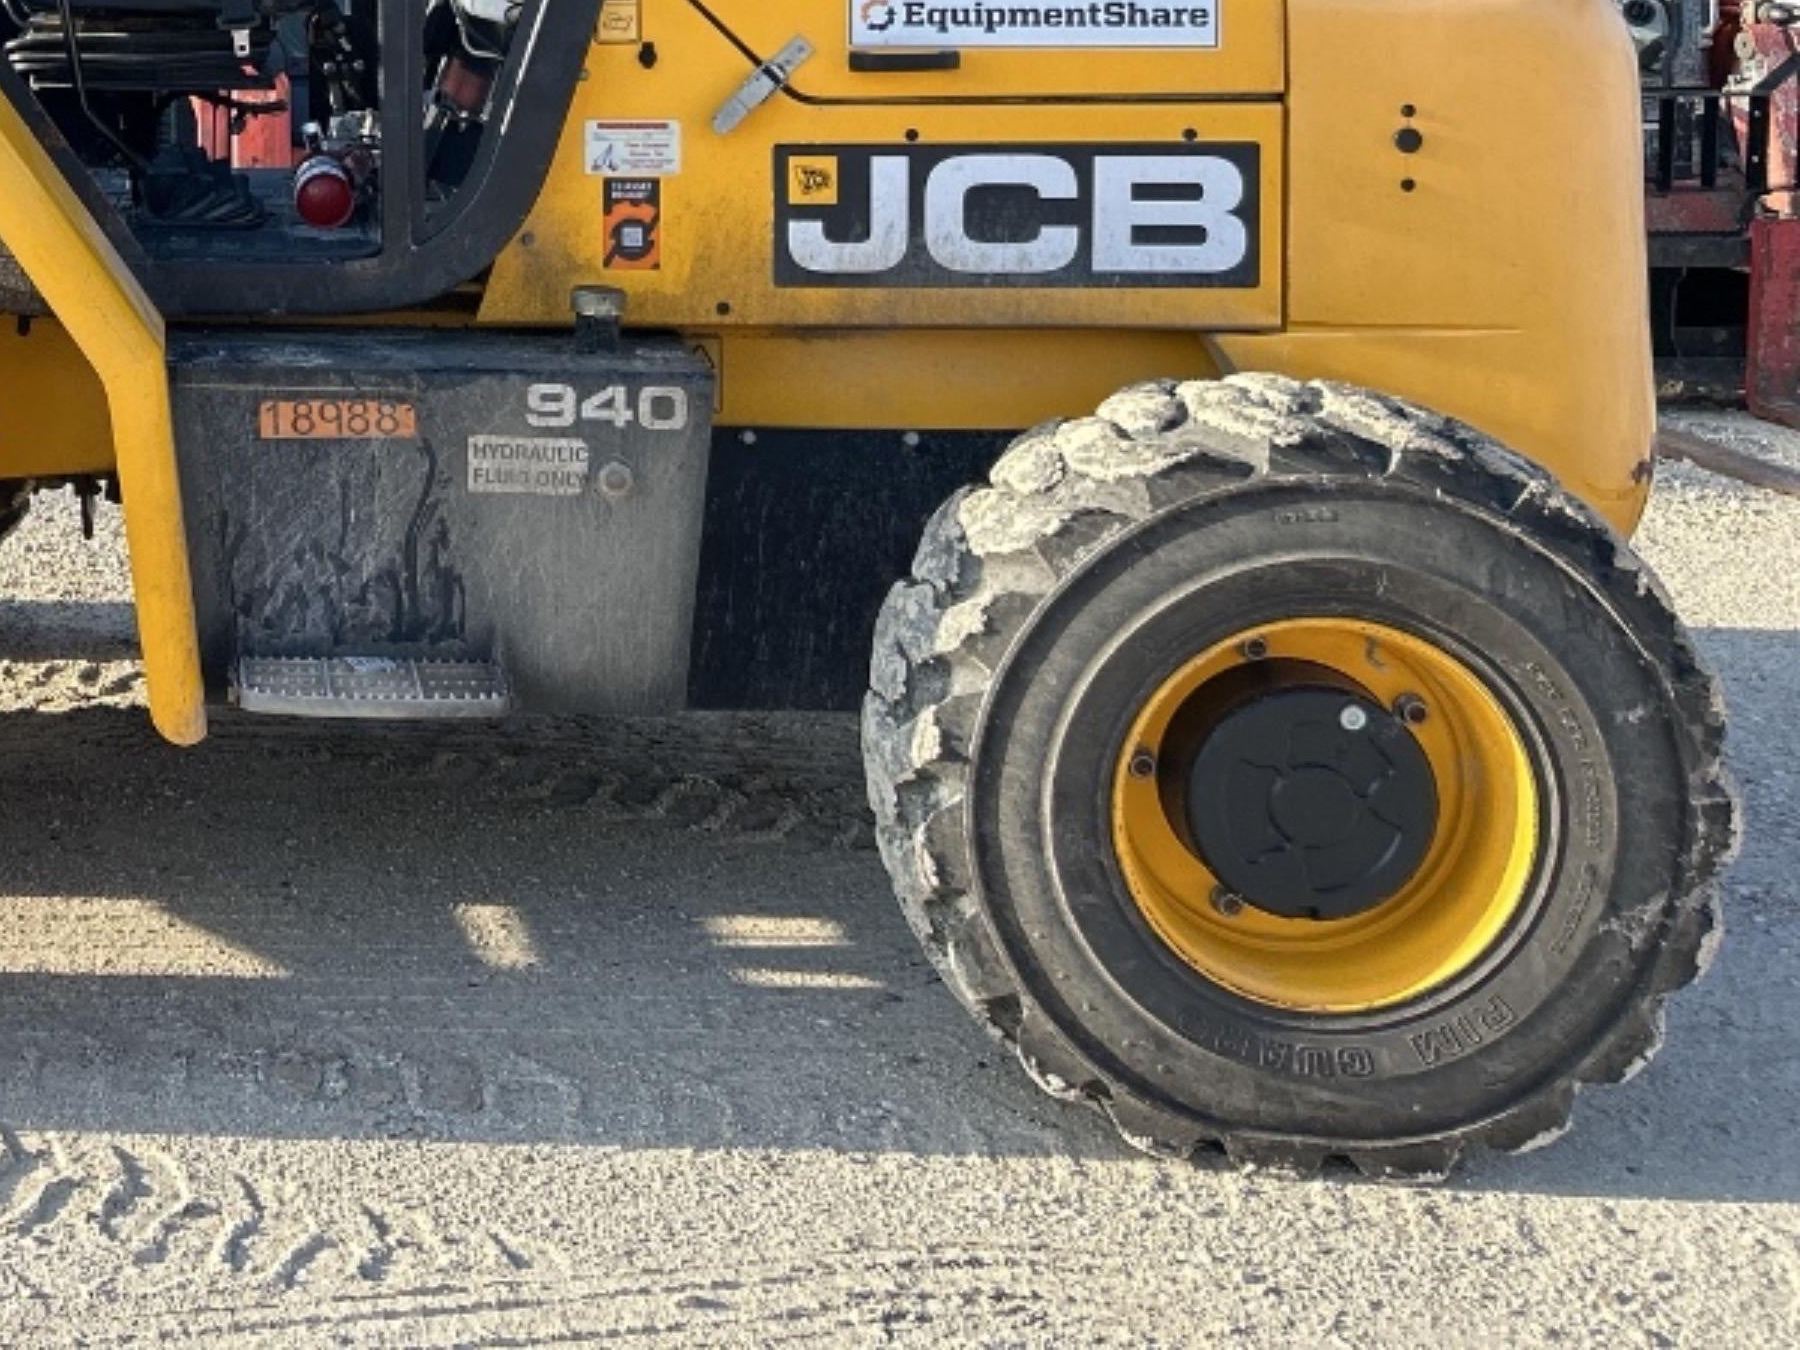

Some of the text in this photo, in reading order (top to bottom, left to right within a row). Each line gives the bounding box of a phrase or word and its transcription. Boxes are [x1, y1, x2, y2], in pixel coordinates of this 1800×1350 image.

[902, 0, 1210, 34] EquipmentShare
[788, 152, 1247, 274] JCB
[525, 382, 688, 430] 940
[473, 442, 588, 464] HYDRAULIC
